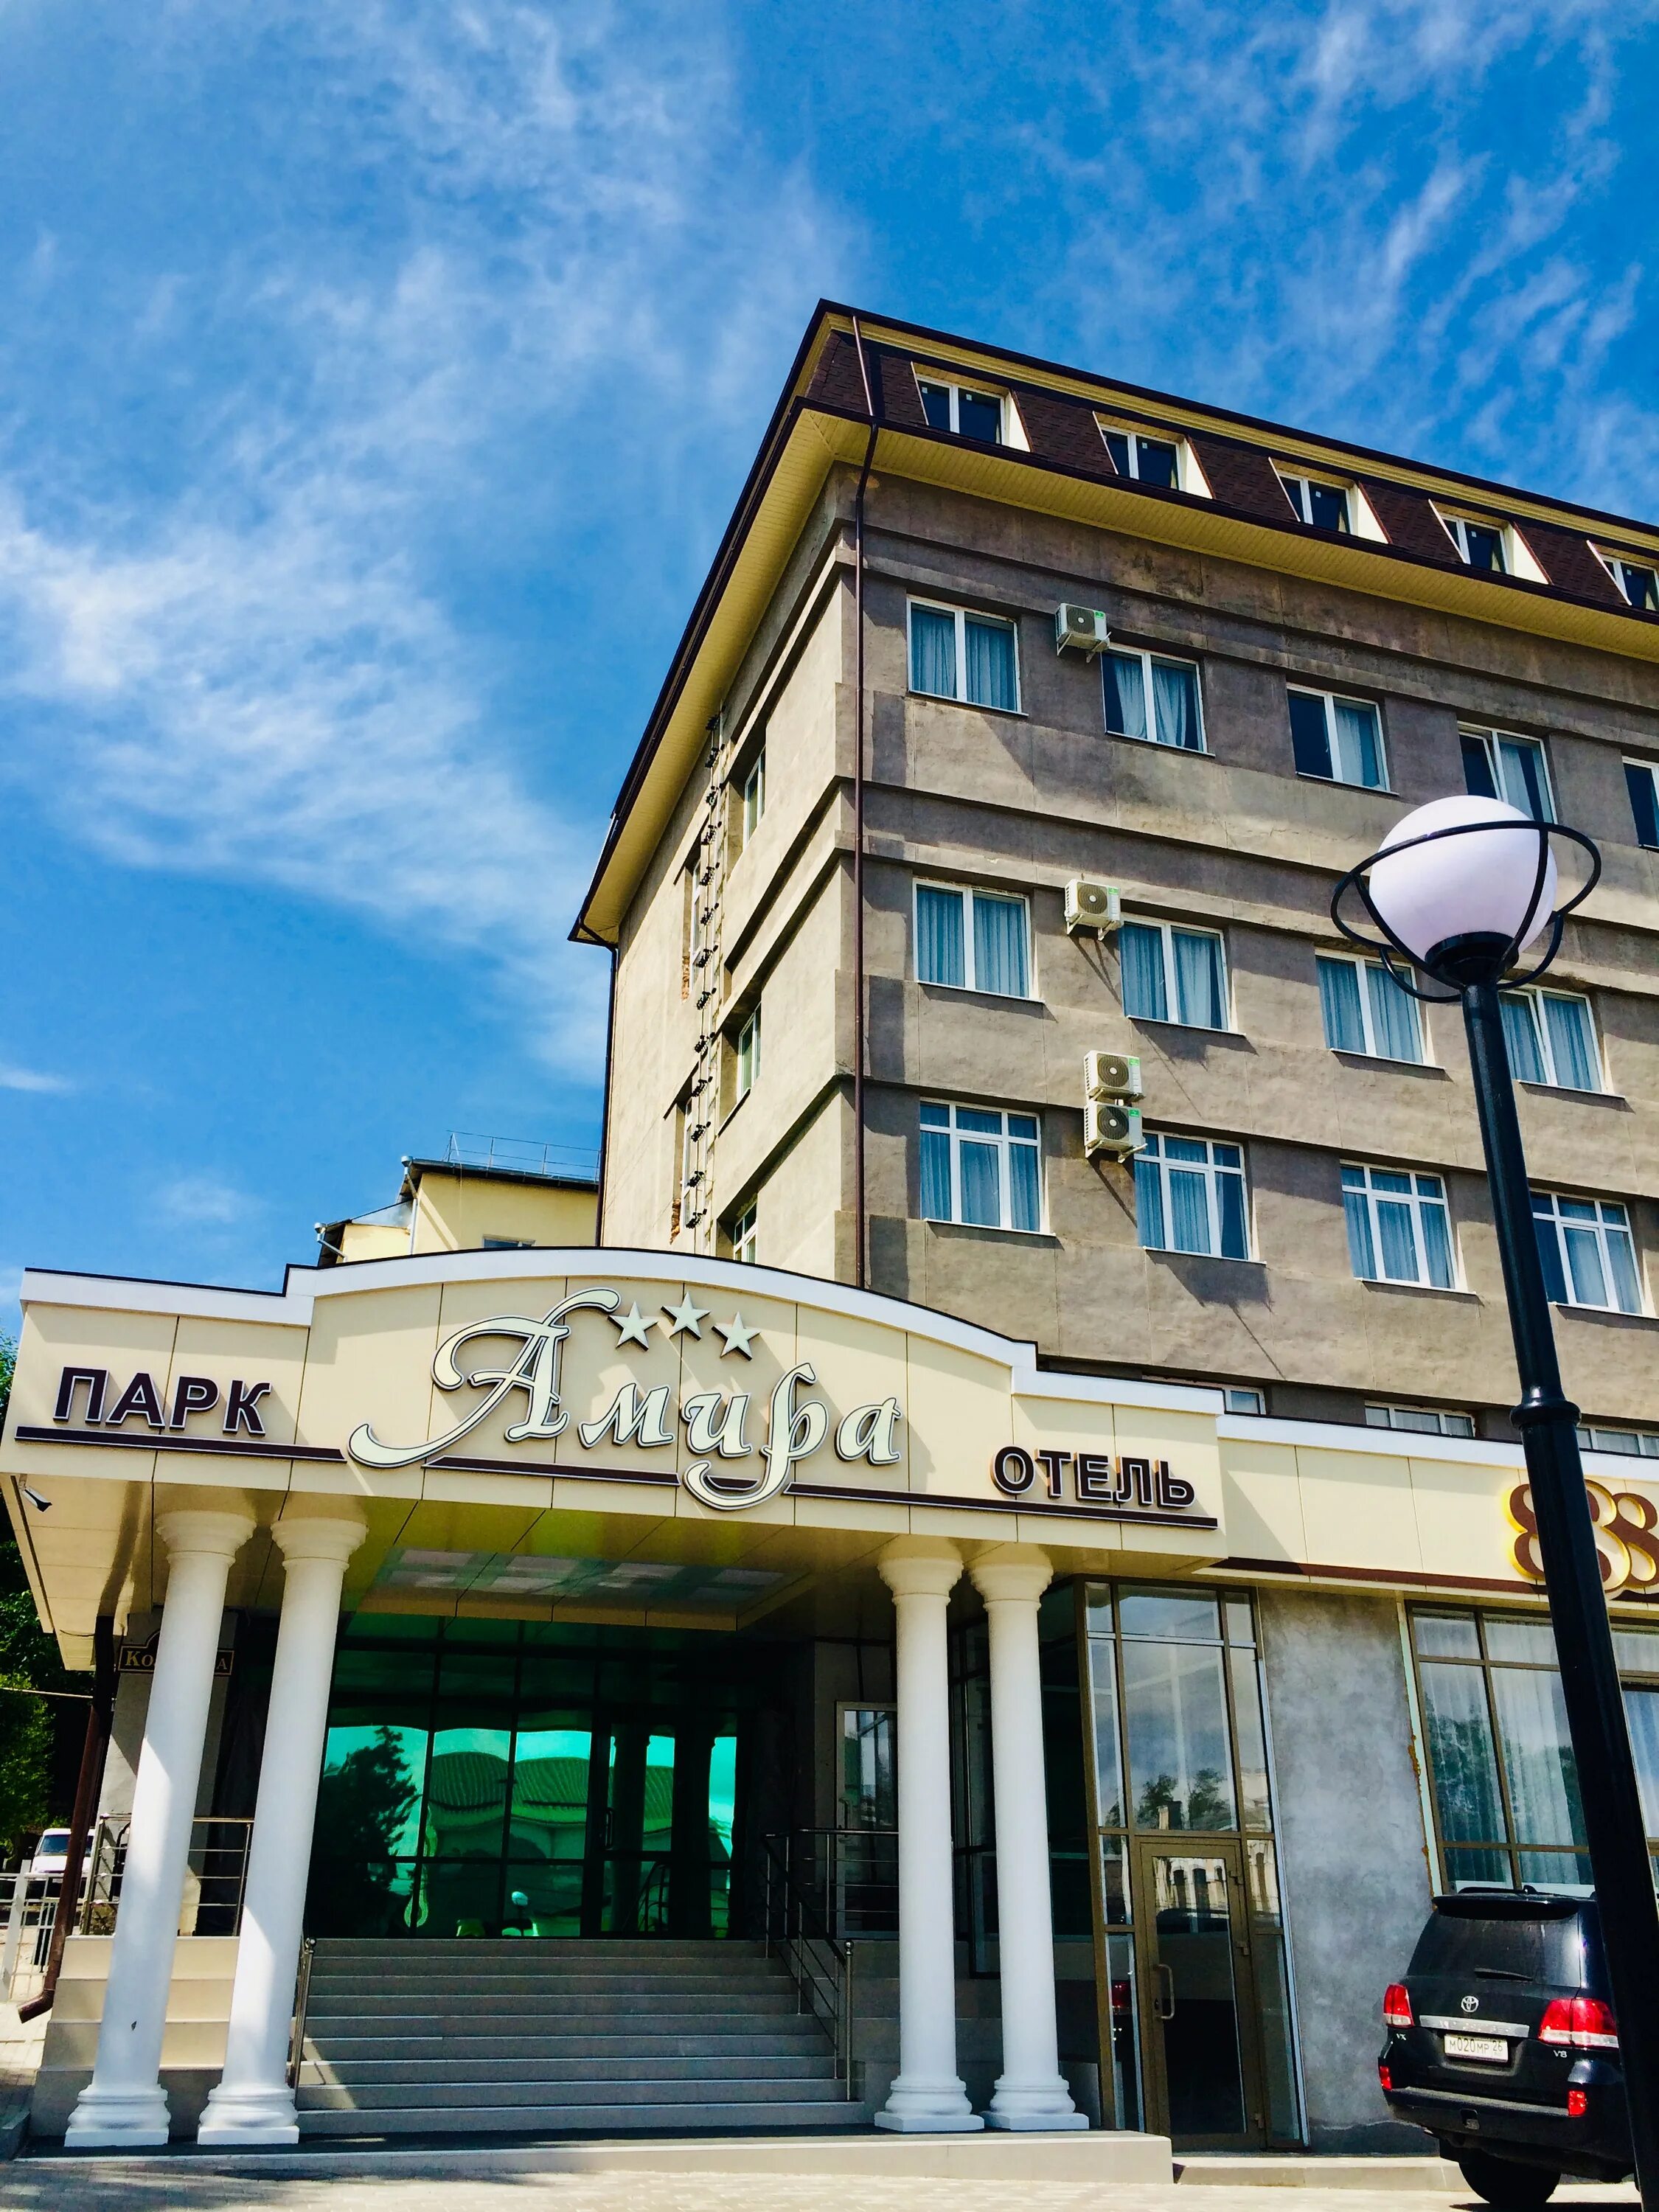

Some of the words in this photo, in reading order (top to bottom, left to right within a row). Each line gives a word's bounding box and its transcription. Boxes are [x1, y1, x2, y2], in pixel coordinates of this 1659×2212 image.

[53, 1366, 272, 1436] ПАРК
[348, 1287, 903, 1509] Амира
[990, 1445, 1197, 1509] ОТЕЛЬ
[1553, 2050, 1568, 2058] V8
